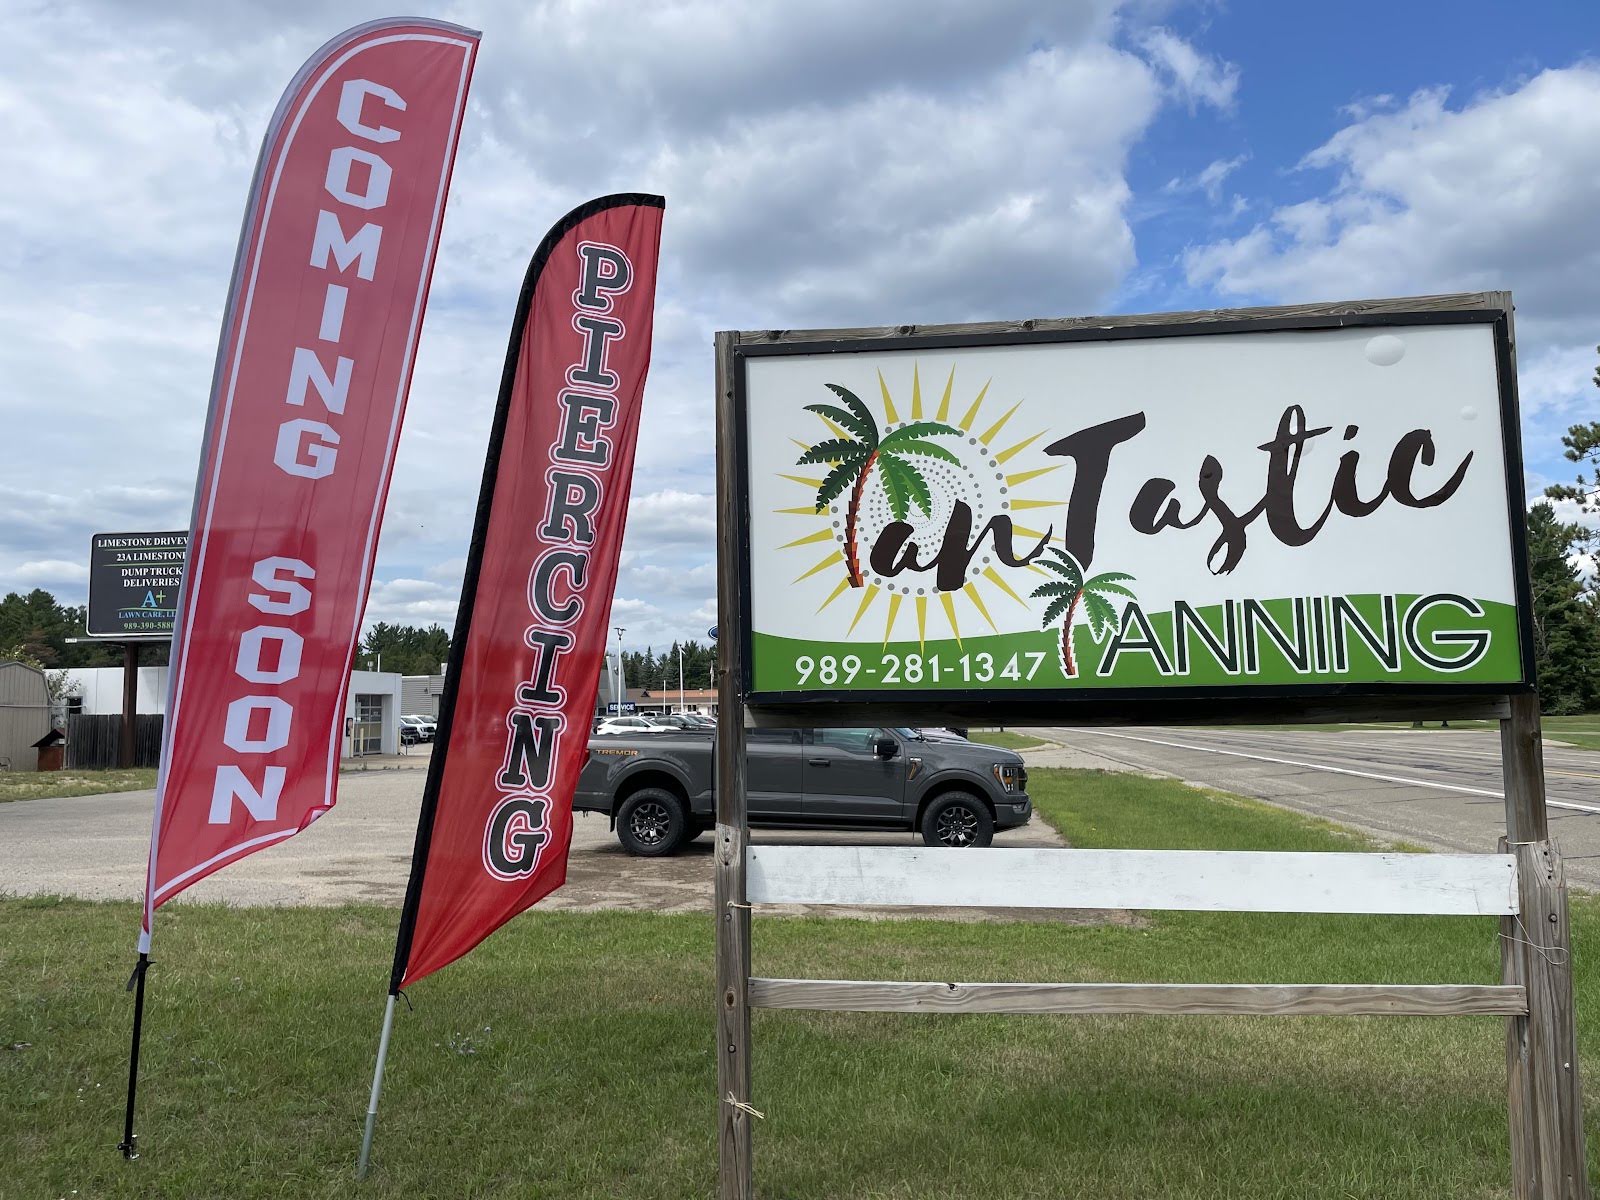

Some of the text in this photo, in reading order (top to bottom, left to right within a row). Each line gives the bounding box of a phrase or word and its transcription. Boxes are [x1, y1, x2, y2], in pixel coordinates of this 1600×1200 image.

[207, 78, 408, 824] COMING SOON
[98, 537, 152, 548] LIMESTONE
[116, 553, 132, 562] 23A
[482, 240, 634, 882] PIERCING
[121, 566, 183, 577] DUMP TRUCK
[123, 577, 180, 587] DELIVERIES
[118, 611, 141, 619] LAWN
[795, 651, 1047, 685] 989-281-1347
